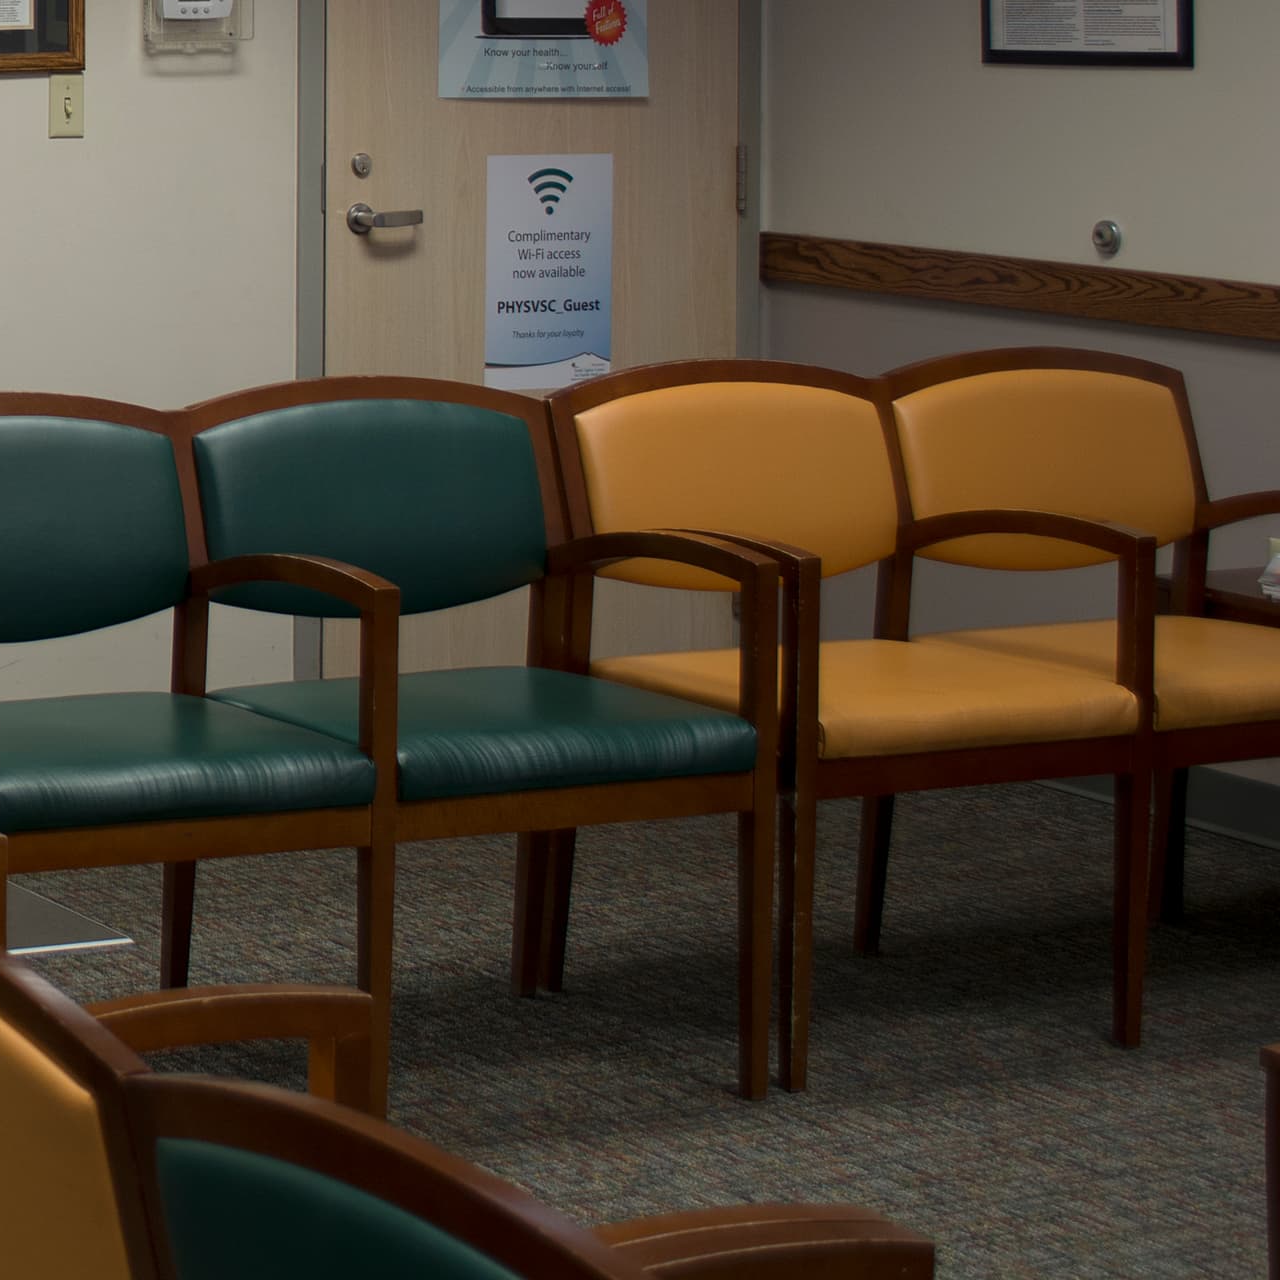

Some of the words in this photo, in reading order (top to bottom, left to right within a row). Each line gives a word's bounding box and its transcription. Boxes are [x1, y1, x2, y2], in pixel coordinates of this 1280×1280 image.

[484, 48, 508, 57] Know
[511, 49, 530, 59] your
[507, 85, 522, 94] from
[507, 229, 591, 245] Complimentary
[518, 248, 545, 261] Wi-Fi
[546, 249, 582, 261] access
[512, 269, 536, 279] now
[538, 266, 587, 279] available
[497, 298, 601, 315] PHYSVSC_Guest
[512, 329, 536, 339] Thanks
[536, 329, 546, 339] for
[546, 330, 562, 340] your
